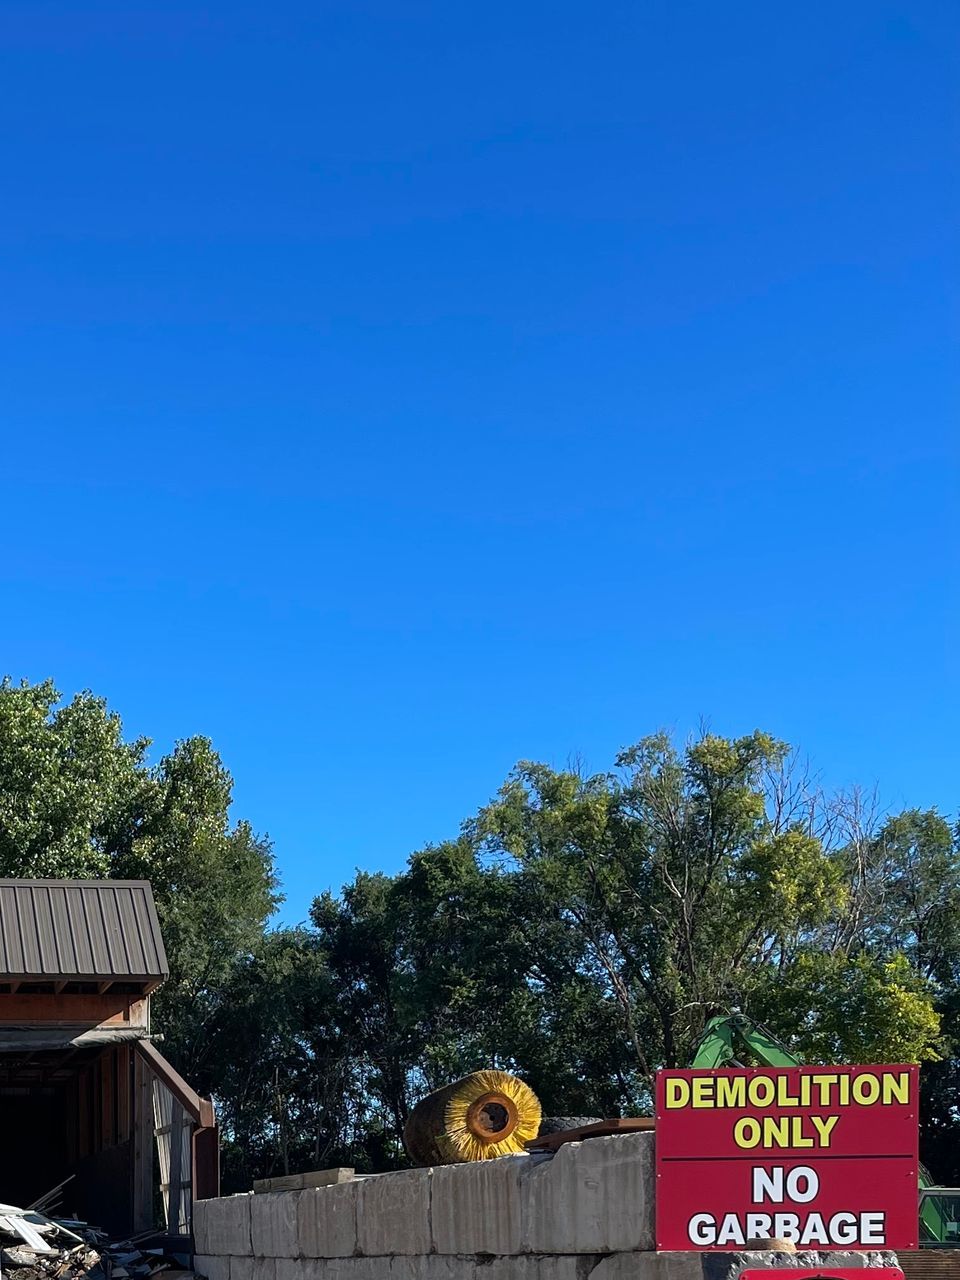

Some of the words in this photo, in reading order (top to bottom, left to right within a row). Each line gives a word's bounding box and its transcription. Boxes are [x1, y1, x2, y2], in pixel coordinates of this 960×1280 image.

[665, 1072, 910, 1109] DEMOLITION
[733, 1115, 840, 1149] ONLY
[751, 1165, 820, 1204] NO
[688, 1212, 886, 1246] GARBAGE
